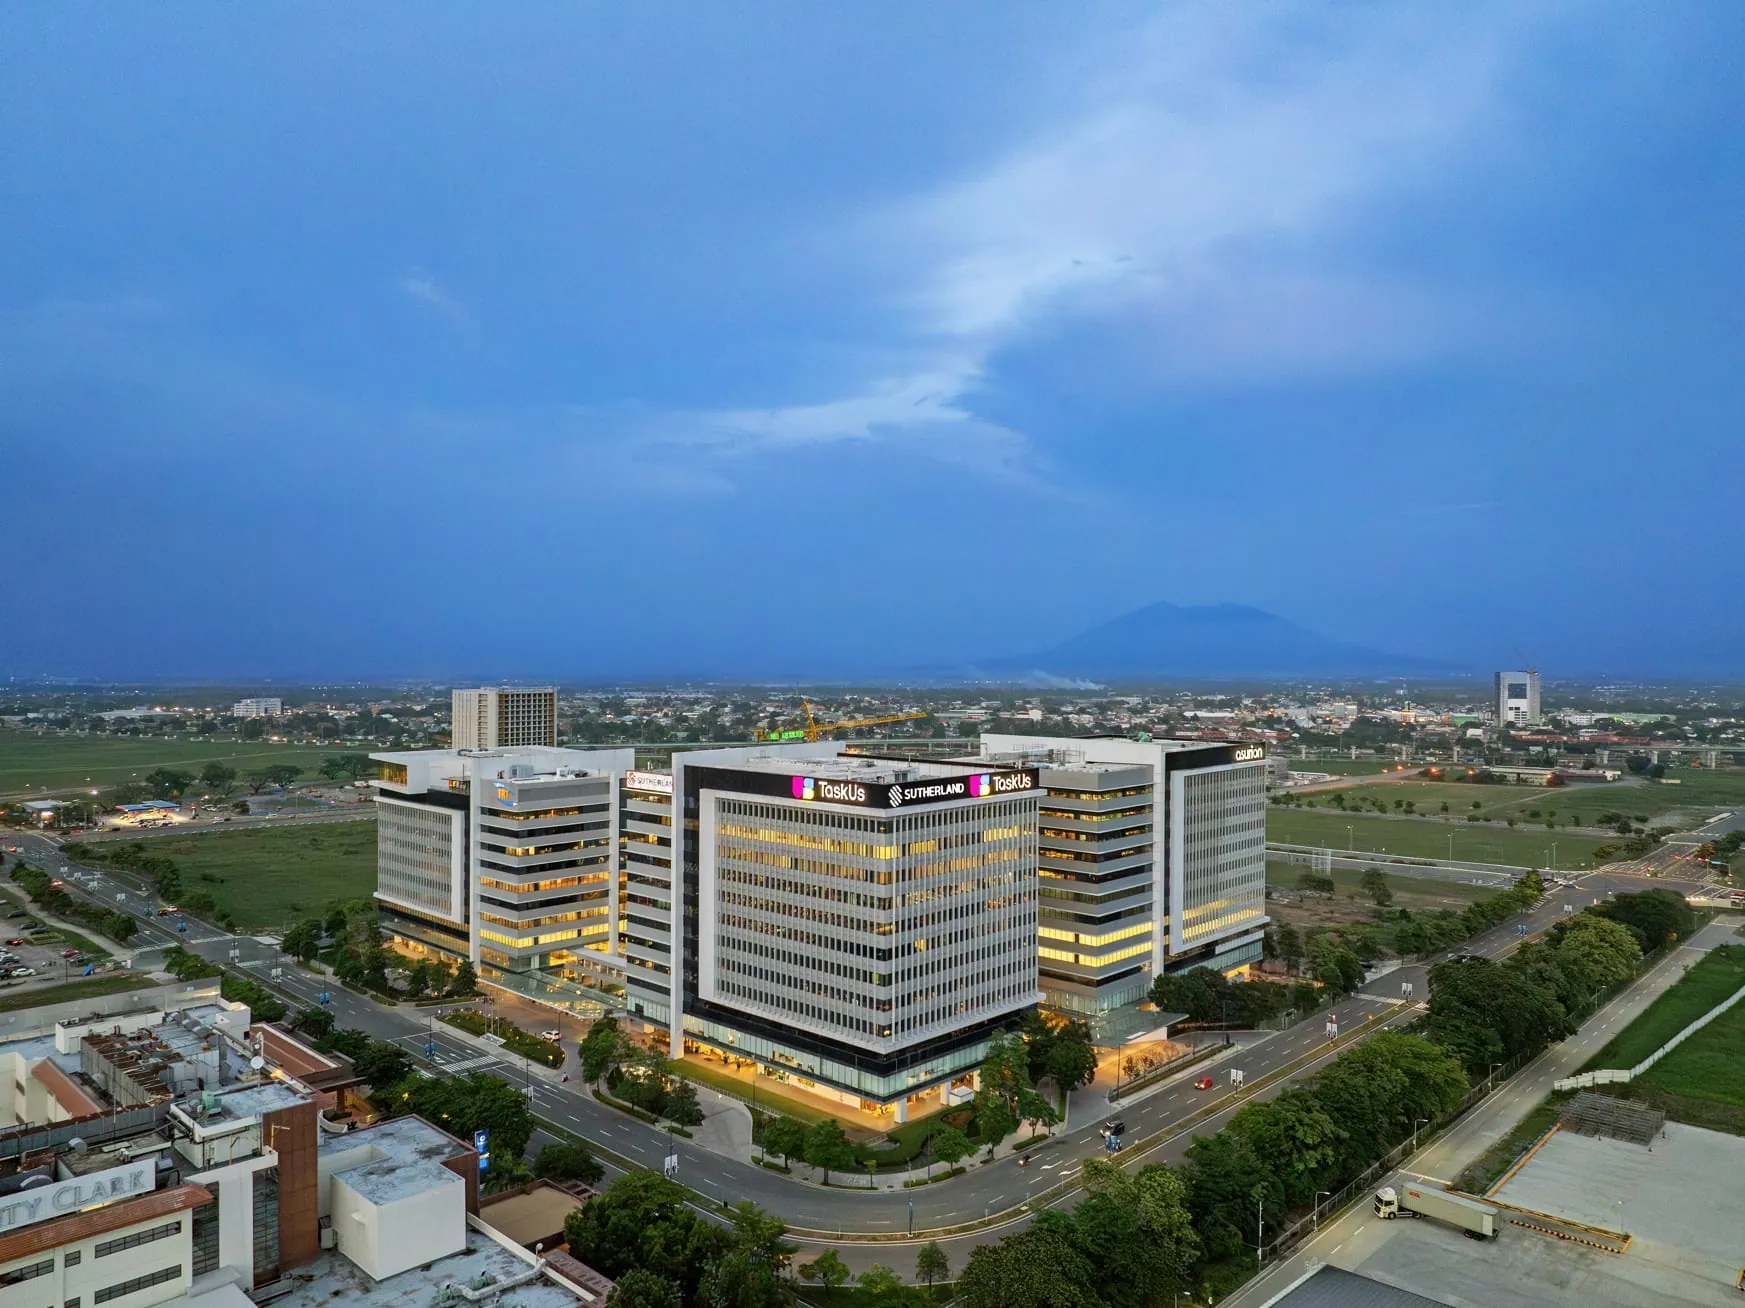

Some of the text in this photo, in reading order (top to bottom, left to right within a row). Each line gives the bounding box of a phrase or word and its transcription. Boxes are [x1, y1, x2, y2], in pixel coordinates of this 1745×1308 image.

[1235, 744, 1263, 761] asurion
[818, 781, 866, 802] TaskUs
[904, 783, 965, 800] SUTHERLAND
[993, 773, 1032, 792] TaskUs
[52, 1169, 146, 1211] CLARK
